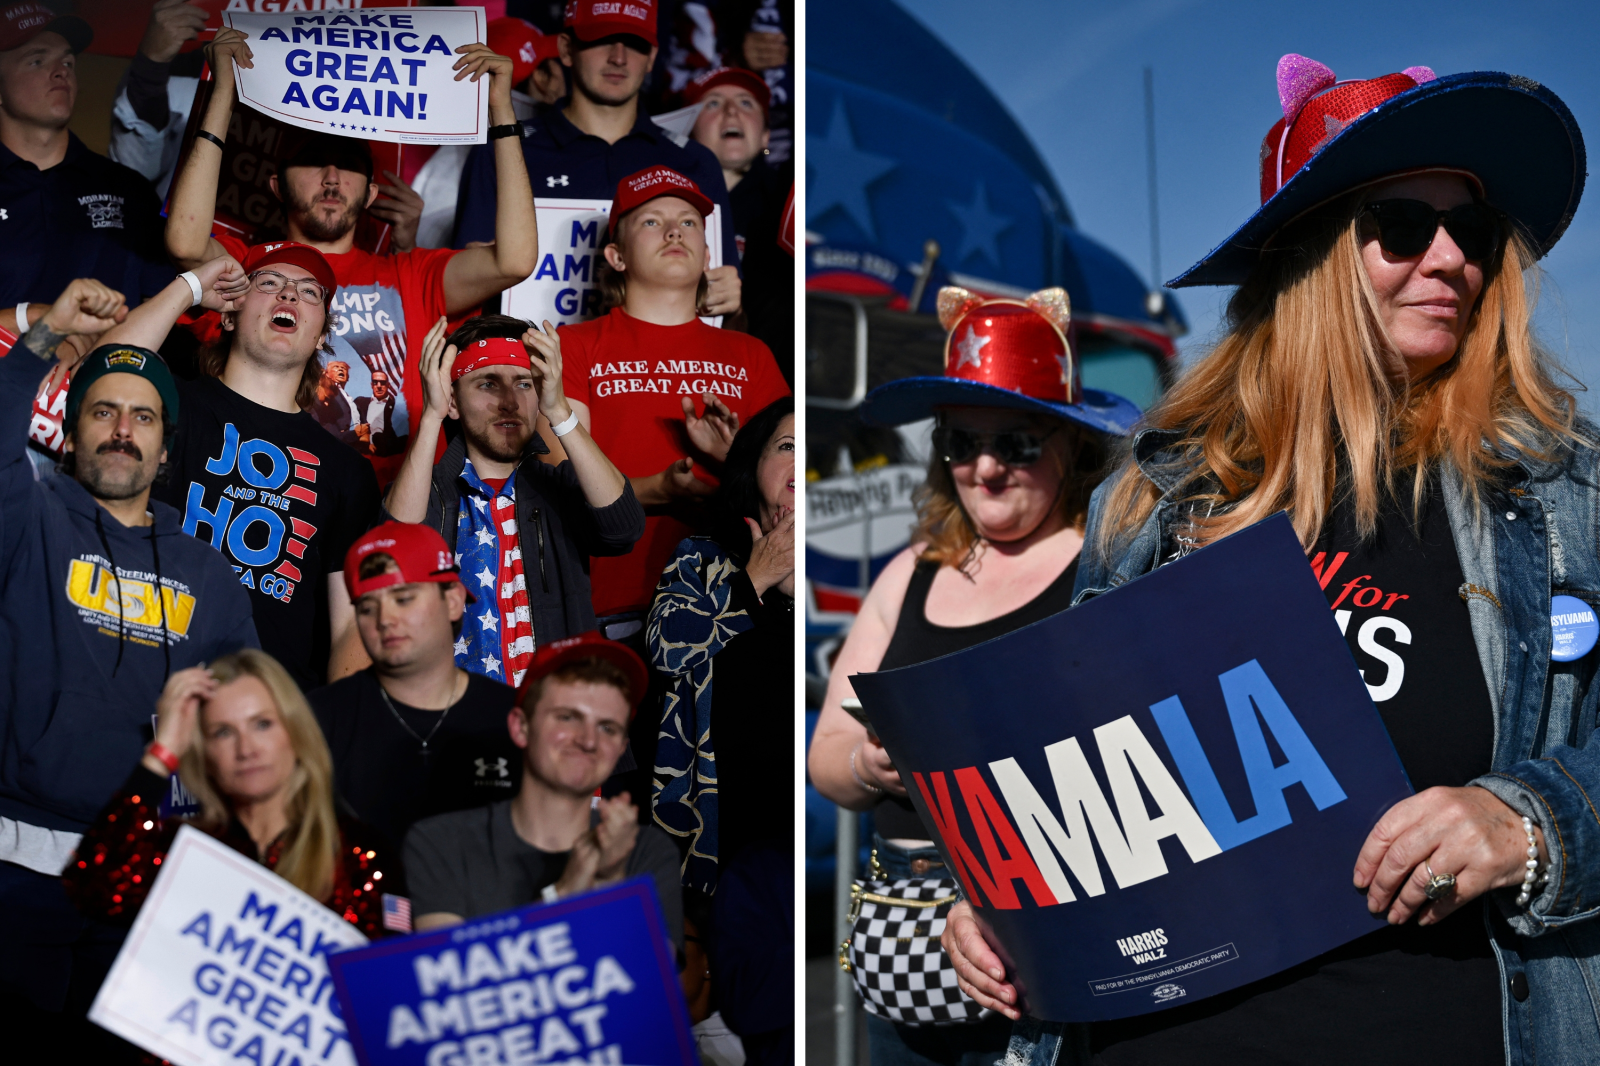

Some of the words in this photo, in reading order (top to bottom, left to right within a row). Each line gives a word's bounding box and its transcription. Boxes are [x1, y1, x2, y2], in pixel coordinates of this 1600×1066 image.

[295, 14, 414, 29] MAKE
[592, 2, 621, 16] GREAT
[623, 4, 648, 20] AGAIN
[259, 27, 452, 56] AMERICA
[285, 49, 426, 86] GREAT
[282, 81, 428, 120] AGAIN!
[628, 172, 653, 187] MAKE
[633, 177, 663, 192] GREAT
[589, 360, 649, 379] MAKE
[653, 360, 748, 381] AMERICA
[596, 378, 672, 397] GREAT
[676, 379, 743, 399] AGAIN
[205, 422, 321, 506] JOE
[223, 484, 257, 501] AND
[260, 491, 290, 511] THE
[66, 558, 196, 637] USW
[1330, 574, 1410, 611] for
[1551, 610, 1595, 627] SYLVANIA
[912, 659, 1348, 909] KAMALA
[237, 890, 344, 959] MAK
[1116, 928, 1168, 957] HARRIS
[412, 920, 578, 997] MAKE
[1095, 982, 1107, 991] PAID
[1106, 981, 1117, 989] FOR
[1116, 980, 1124, 988] BY
[1124, 977, 1136, 986] THE
[1135, 967, 1175, 984] PENNSYLVANIA
[1174, 956, 1211, 973] DEMOCRATIC
[1210, 949, 1230, 962] PARTY
[1132, 947, 1168, 965] WALZ
[192, 960, 358, 1060] GREAT
[382, 953, 638, 1049] AMERICA
[424, 1003, 608, 1066] GREAT
